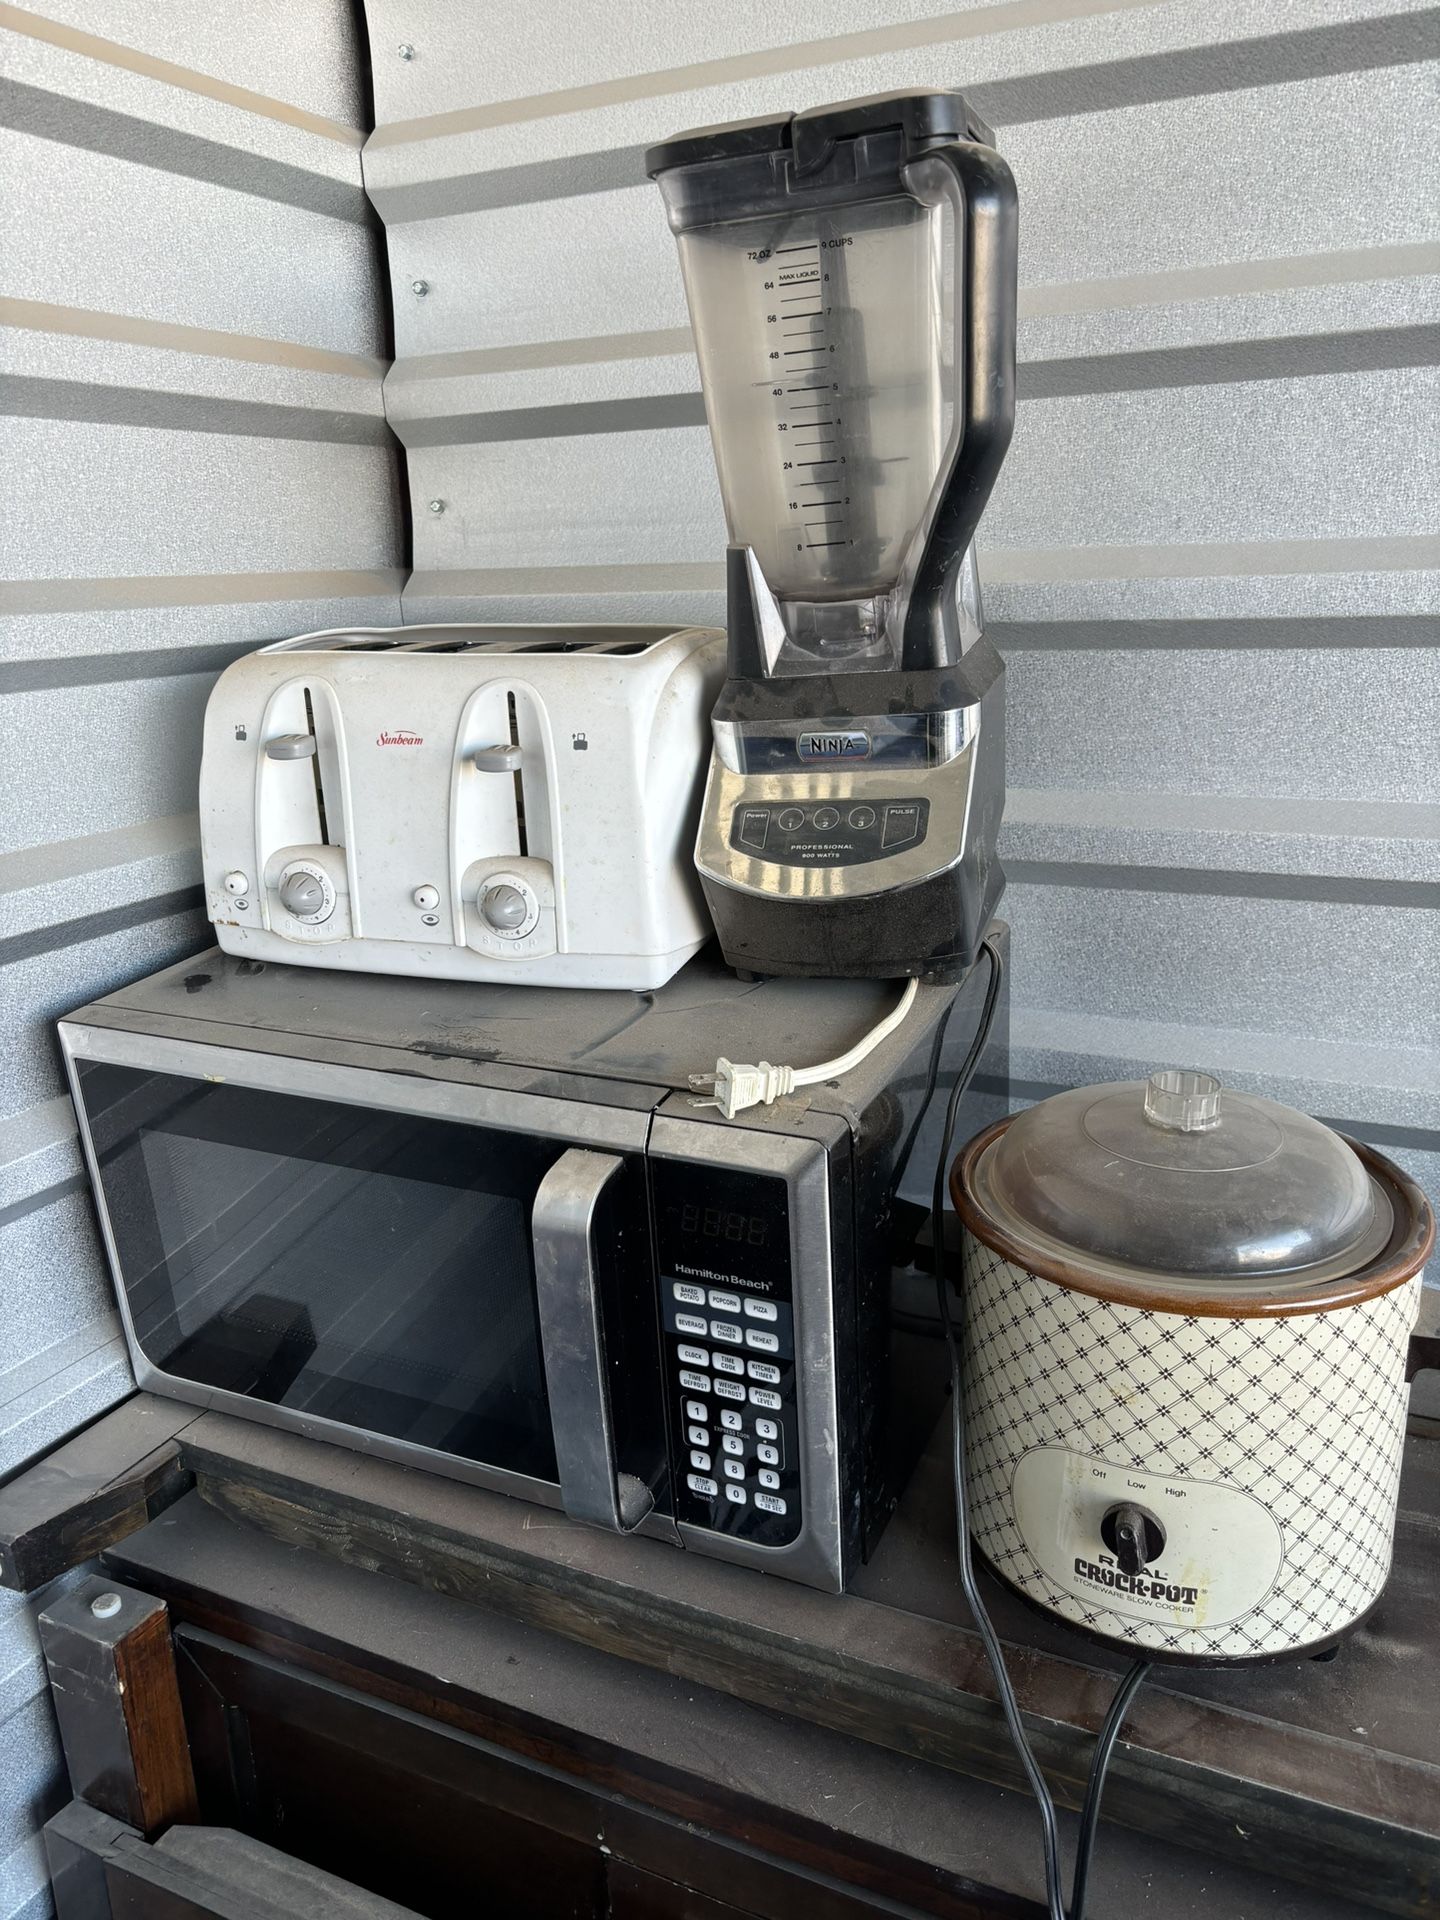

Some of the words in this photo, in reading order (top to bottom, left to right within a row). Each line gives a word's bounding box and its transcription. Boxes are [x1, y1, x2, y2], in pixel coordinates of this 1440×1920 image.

[821, 241, 827, 249] 9
[828, 237, 853, 248] CUPS
[747, 252, 757, 260] 72
[758, 249, 771, 258] OZ
[779, 273, 795, 281] MAX
[796, 270, 819, 279] LIQUID
[764, 282, 774, 290] 64
[767, 314, 777, 323] 56
[769, 352, 779, 360] 48
[772, 388, 782, 396] 40
[783, 462, 792, 470] 24
[789, 502, 798, 510] 16
[376, 731, 423, 746] Sunbeam
[810, 737, 855, 754] NINJA
[482, 936, 537, 950] STOP
[674, 1263, 730, 1282] Hamilton
[680, 1286, 698, 1295] BAKED
[680, 1292, 700, 1302] POTATO
[712, 1296, 737, 1307] POPCORN
[753, 1305, 768, 1314] PIZZA
[678, 1318, 704, 1330] BEVERAGE
[716, 1324, 737, 1333] FROZEN
[717, 1330, 736, 1340] DINNER
[752, 1336, 772, 1345] REHEAT
[684, 1350, 702, 1360] CLOCK
[721, 1356, 735, 1364] TIME
[720, 1362, 736, 1371] COOK
[752, 1363, 776, 1374] KITCHEN
[688, 1374, 702, 1382] TIME
[755, 1371, 773, 1380] TIMER
[683, 1379, 707, 1390] DEFROST
[718, 1381, 740, 1392] WEIGHT
[718, 1387, 742, 1398] DEFROST
[754, 1390, 776, 1400] POWER
[757, 1397, 774, 1406] LEVEL
[694, 1407, 700, 1416] 1
[728, 1416, 735, 1425] 2
[763, 1424, 770, 1434] 3
[696, 1432, 702, 1440] 4
[736, 1432, 750, 1440] COOK
[730, 1441, 737, 1450] 5
[764, 1450, 771, 1459] 6
[697, 1456, 704, 1464] 7
[731, 1465, 738, 1474] 8
[1092, 1468, 1107, 1480] Off
[695, 1477, 710, 1486] STOP
[766, 1474, 773, 1484] 9
[694, 1483, 712, 1492] CLEAR
[1127, 1479, 1146, 1490] Low
[733, 1490, 740, 1499] 0
[1165, 1487, 1187, 1499] High
[761, 1496, 779, 1504] START
[1098, 1554, 1168, 1580] RAL
[1073, 1575, 1125, 1600] STONEWARE
[1126, 1594, 1153, 1606] SLOW
[1154, 1601, 1194, 1613] COOKER
